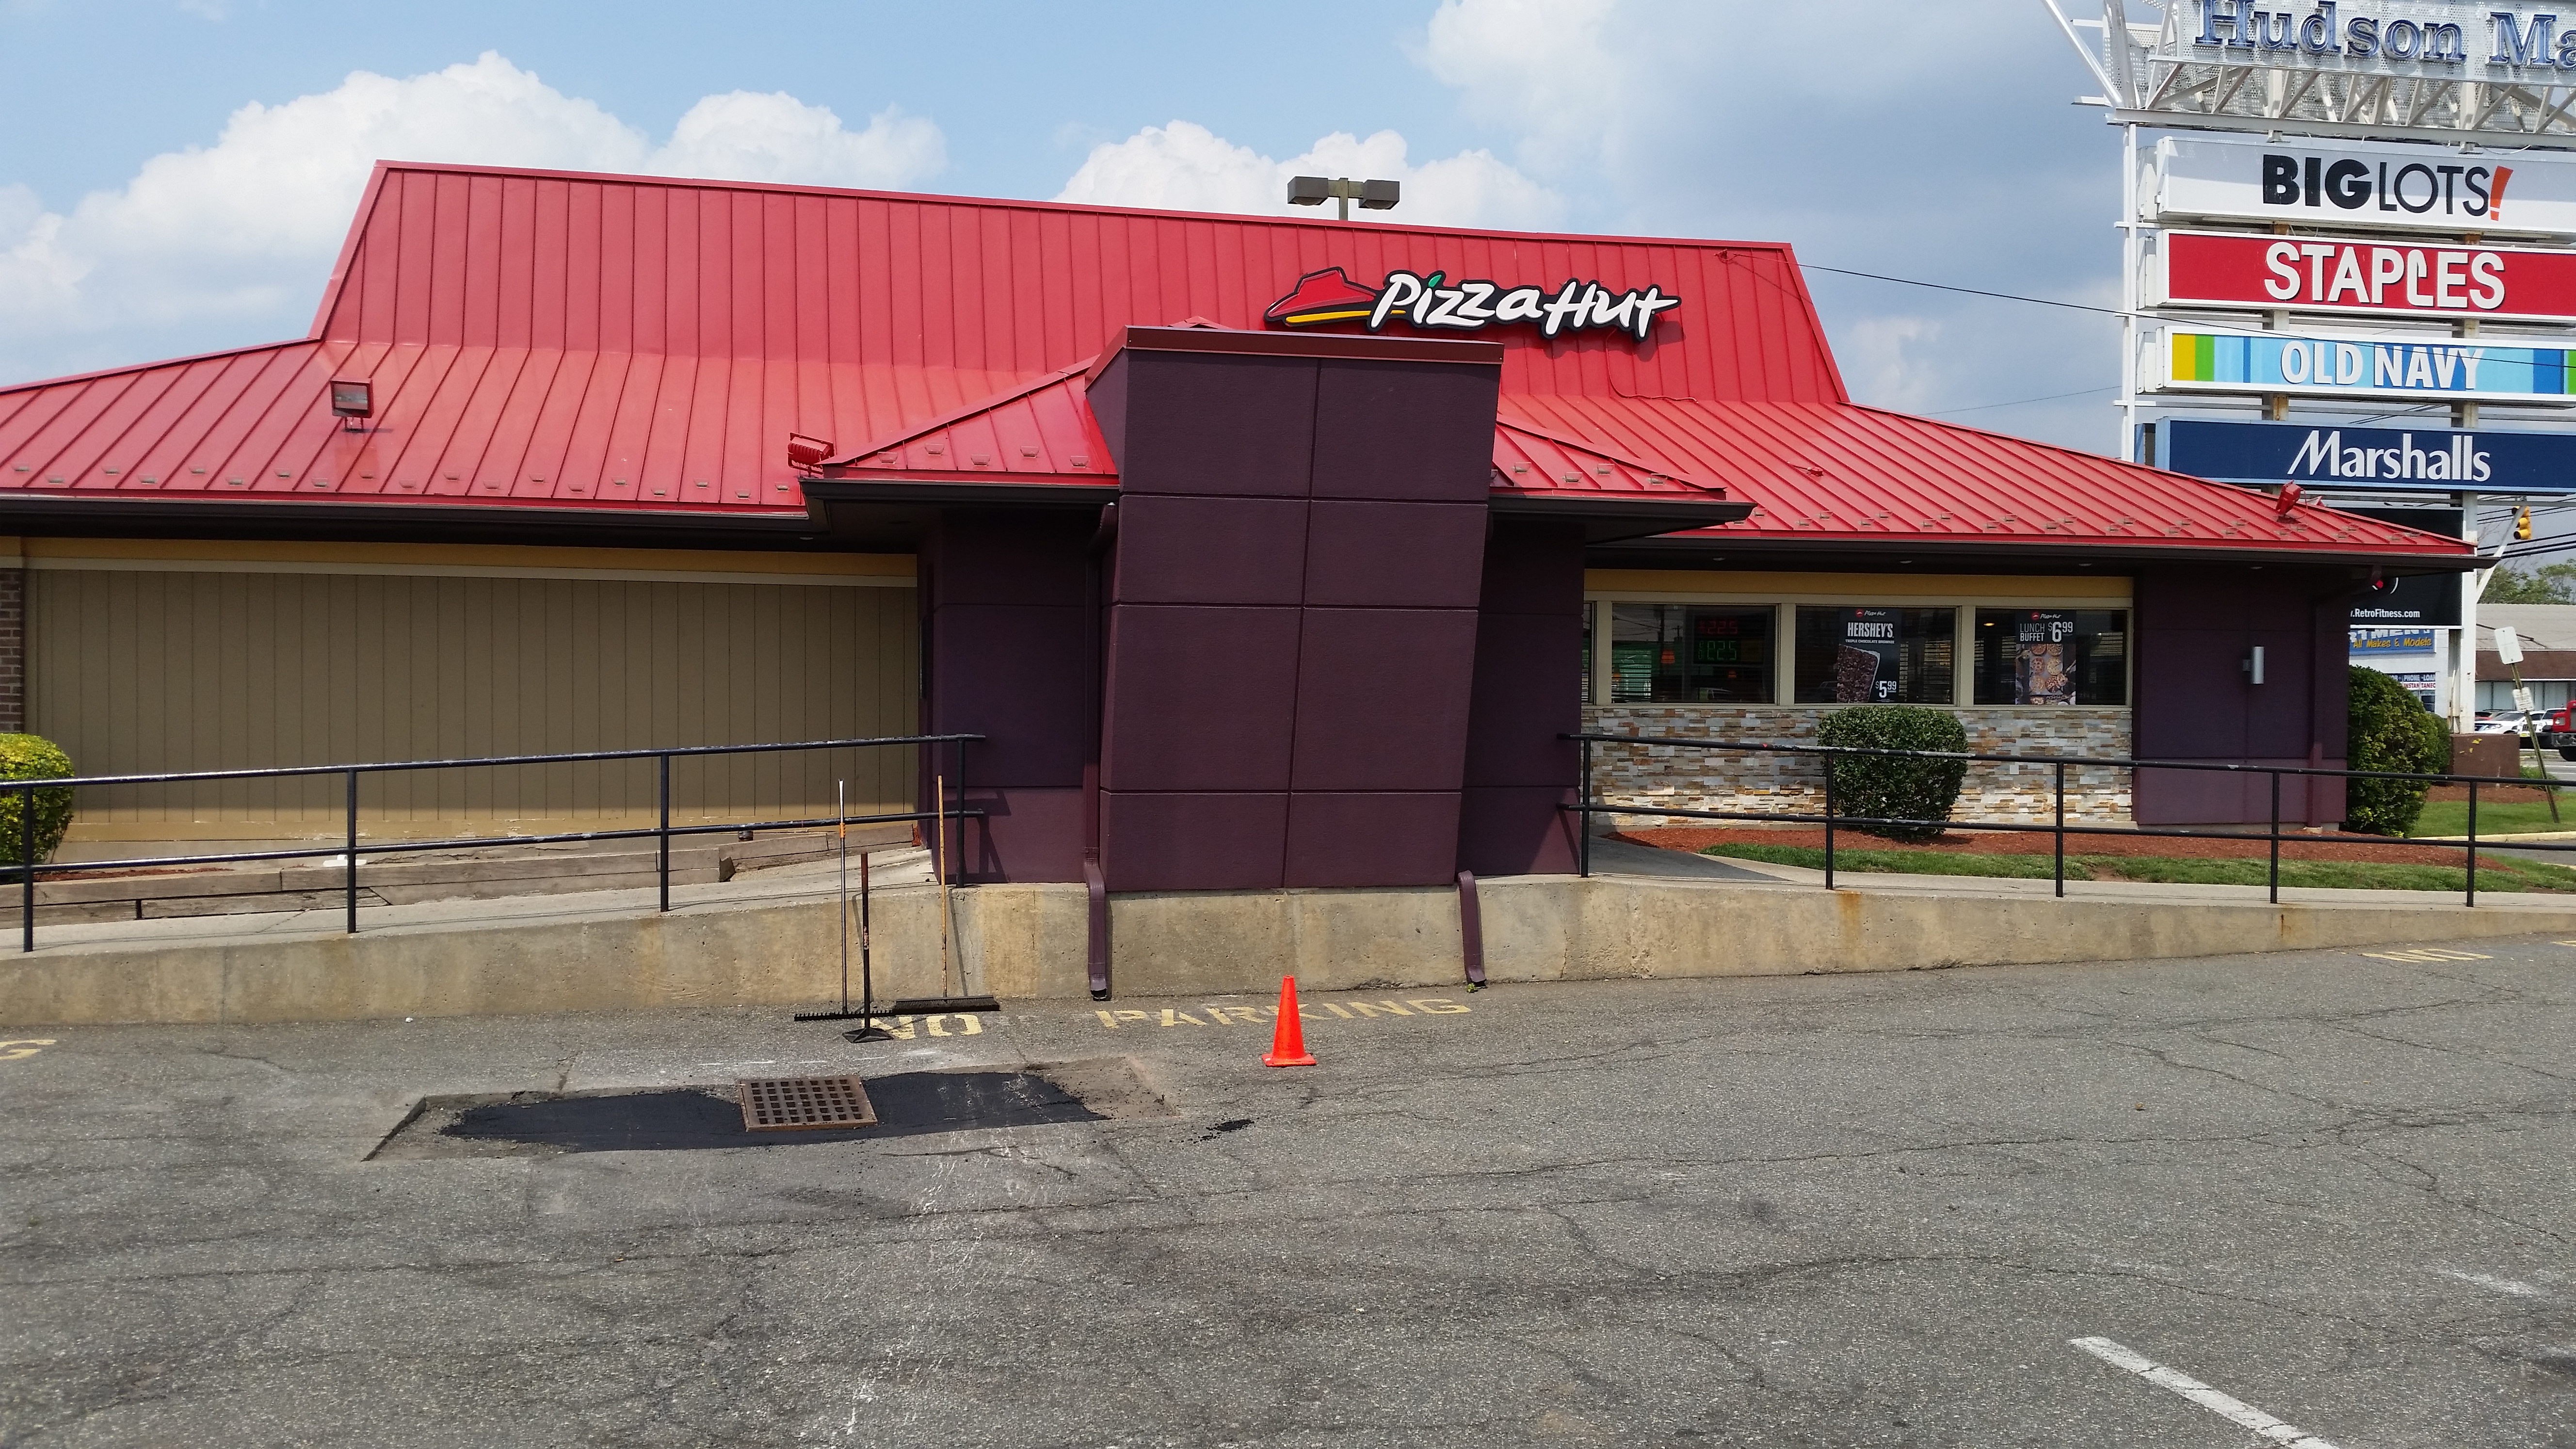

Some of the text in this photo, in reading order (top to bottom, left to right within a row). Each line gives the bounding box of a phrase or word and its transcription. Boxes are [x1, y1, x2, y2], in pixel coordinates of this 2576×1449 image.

[2192, 0, 2466, 63] Hudson
[2264, 242, 2506, 309] STAPLES
[1370, 272, 1681, 338] Pizza Hut
[2281, 340, 2485, 390] OLD NAVY
[2286, 430, 2491, 482] Marshalls
[1847, 622, 1894, 638] HERSHEY'S
[2020, 623, 2045, 632] LUNCH
[2020, 632, 2045, 642] BUFFET
[2353, 636, 2431, 648] All Makes & Models
[861, 1014, 983, 1040] NO
